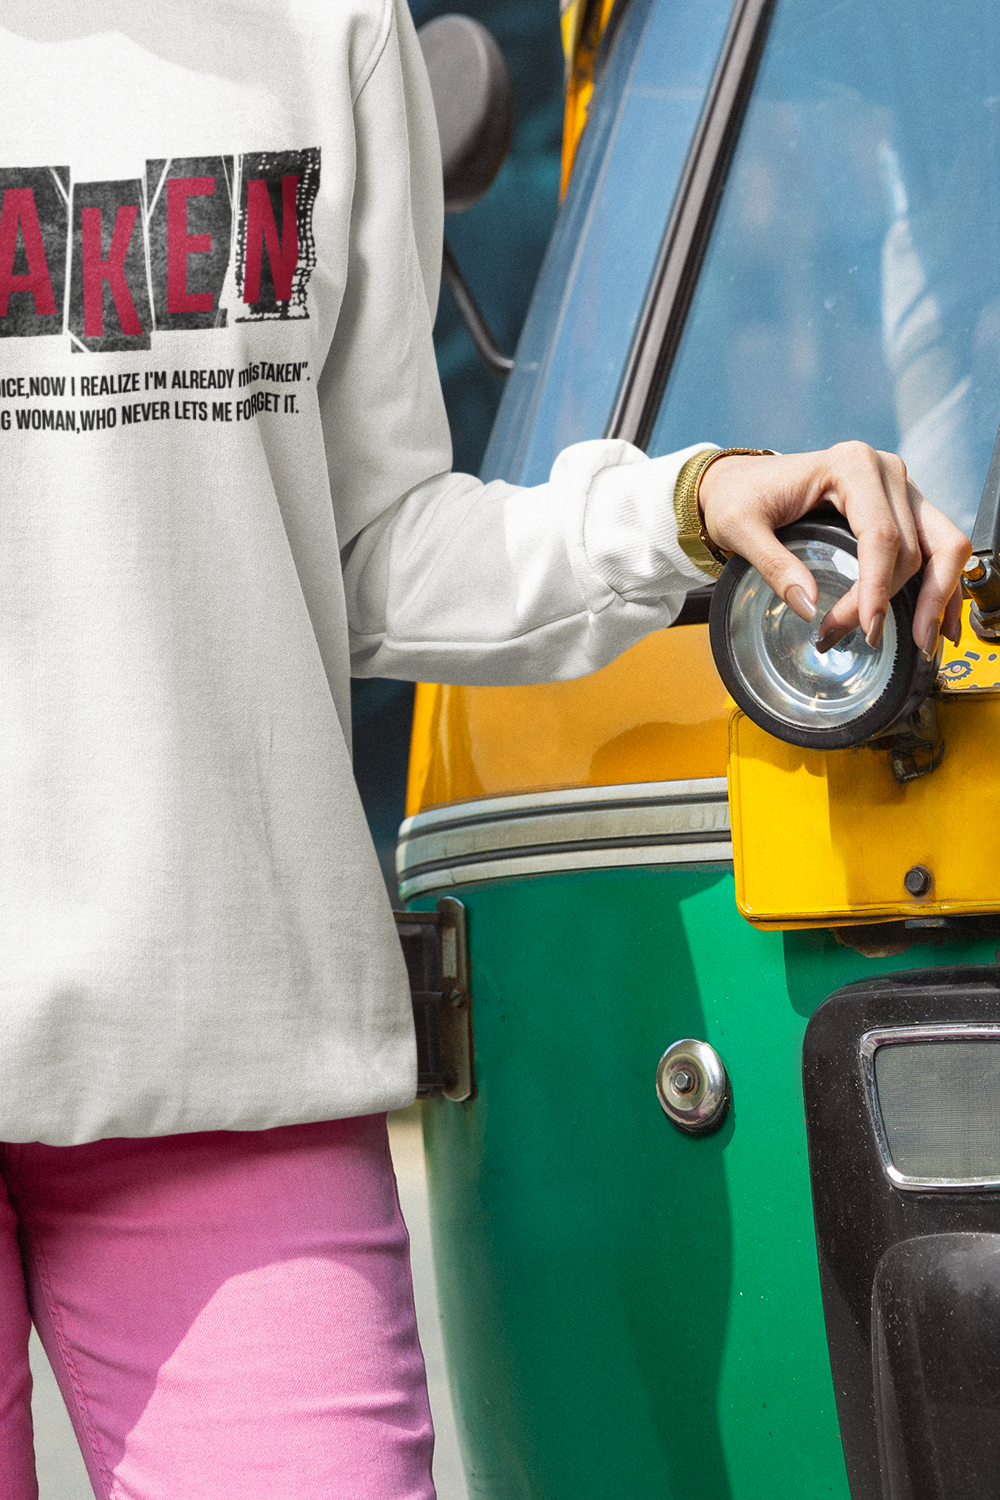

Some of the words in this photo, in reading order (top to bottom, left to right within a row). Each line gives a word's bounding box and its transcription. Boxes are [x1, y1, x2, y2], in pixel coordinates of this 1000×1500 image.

[70, 376, 76, 397] I
[81, 372, 140, 396] REALIZE
[145, 370, 166, 390] I'M
[171, 368, 234, 389] ALREADY
[122, 401, 170, 425] NEVER
[174, 401, 207, 421] LETS
[212, 402, 232, 421] ME
[236, 391, 280, 421] FORGET
[284, 394, 299, 413] IT.
